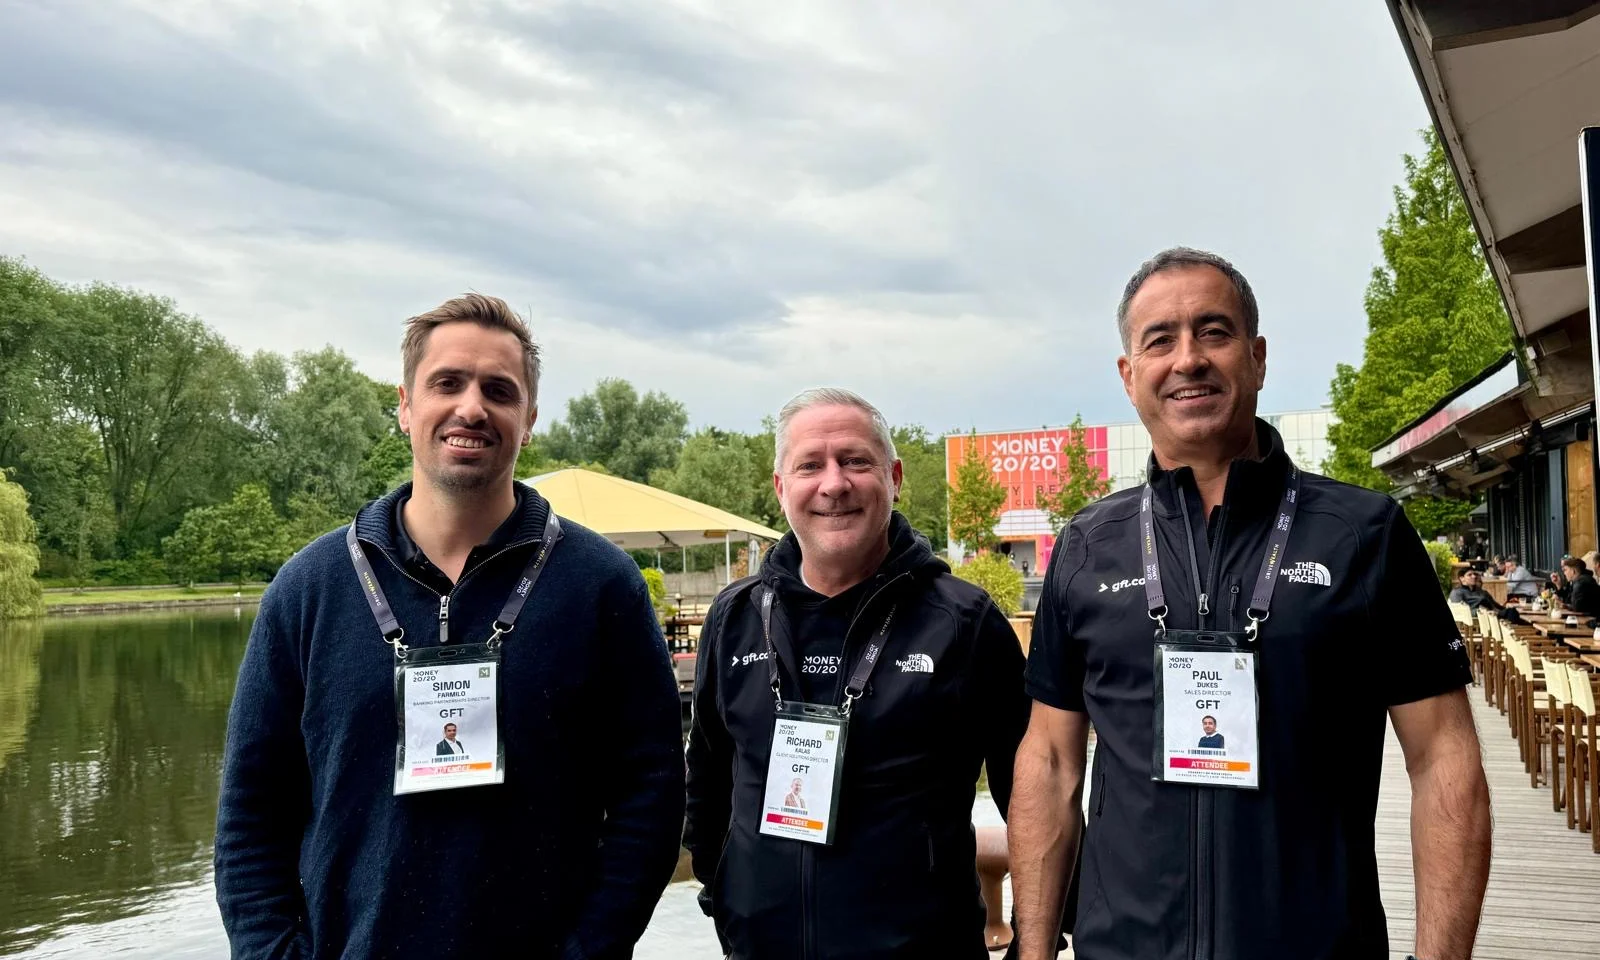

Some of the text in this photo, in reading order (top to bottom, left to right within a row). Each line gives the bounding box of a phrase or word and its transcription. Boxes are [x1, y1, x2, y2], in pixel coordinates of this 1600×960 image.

[992, 437, 1064, 455] MONEY
[991, 455, 1057, 472] 20/20
[1295, 561, 1315, 570] THE
[1280, 568, 1315, 576] NORTH
[1111, 577, 1146, 592] gft.co
[1288, 575, 1315, 584] FACE
[516, 576, 529, 594] 20/20
[520, 580, 532, 598] MONEY
[742, 652, 777, 666] gft.co
[803, 656, 842, 665] MONEY
[907, 653, 922, 661] THE
[895, 659, 921, 667] NORTH
[801, 665, 838, 674] 20/20
[901, 665, 921, 673] FACE
[1192, 671, 1223, 681] PAUL
[432, 680, 471, 692] SIMON
[437, 691, 466, 699] FARMILO
[1195, 700, 1221, 710] GFT
[439, 708, 465, 719] GFT
[786, 736, 822, 749] RICHARD
[791, 764, 810, 774] GFT
[1191, 761, 1229, 770] ATTENDEE
